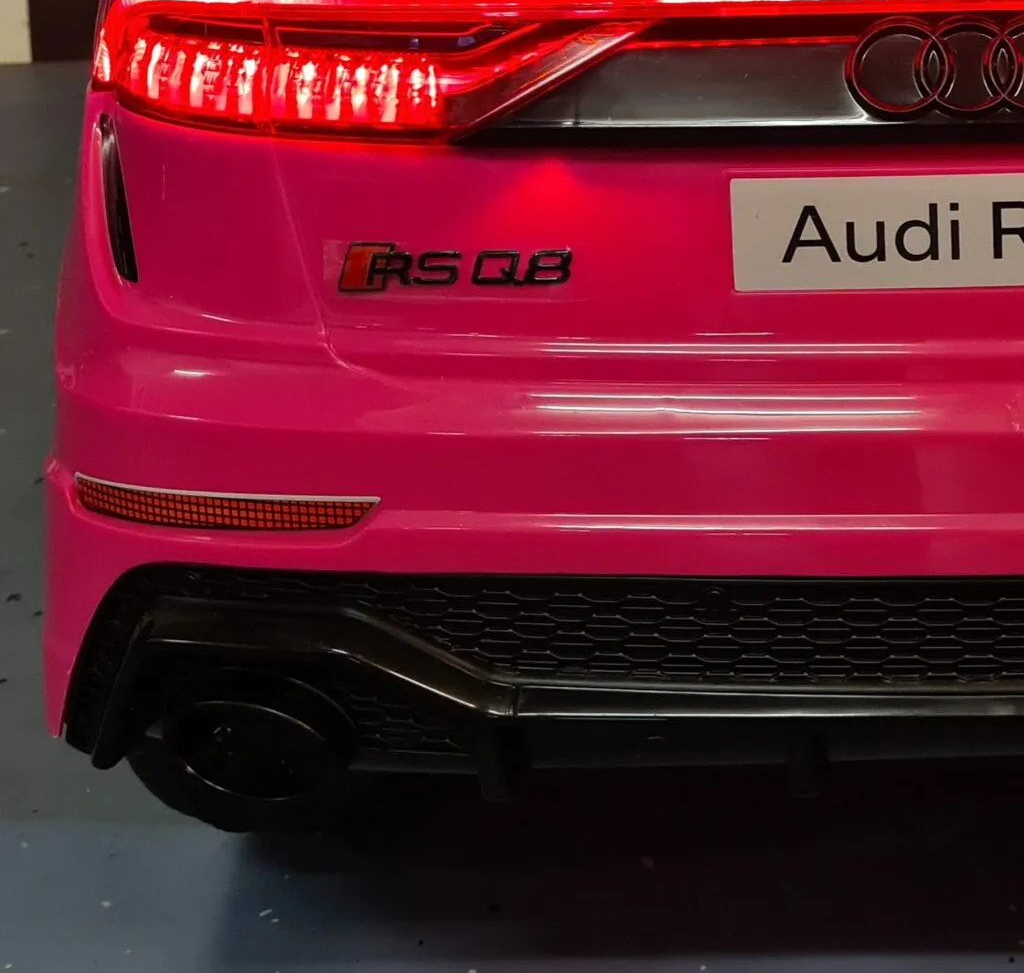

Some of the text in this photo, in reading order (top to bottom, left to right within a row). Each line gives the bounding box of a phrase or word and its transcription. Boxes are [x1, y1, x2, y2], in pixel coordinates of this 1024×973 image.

[781, 202, 961, 264] Audi
[365, 248, 573, 287] RS Q8
